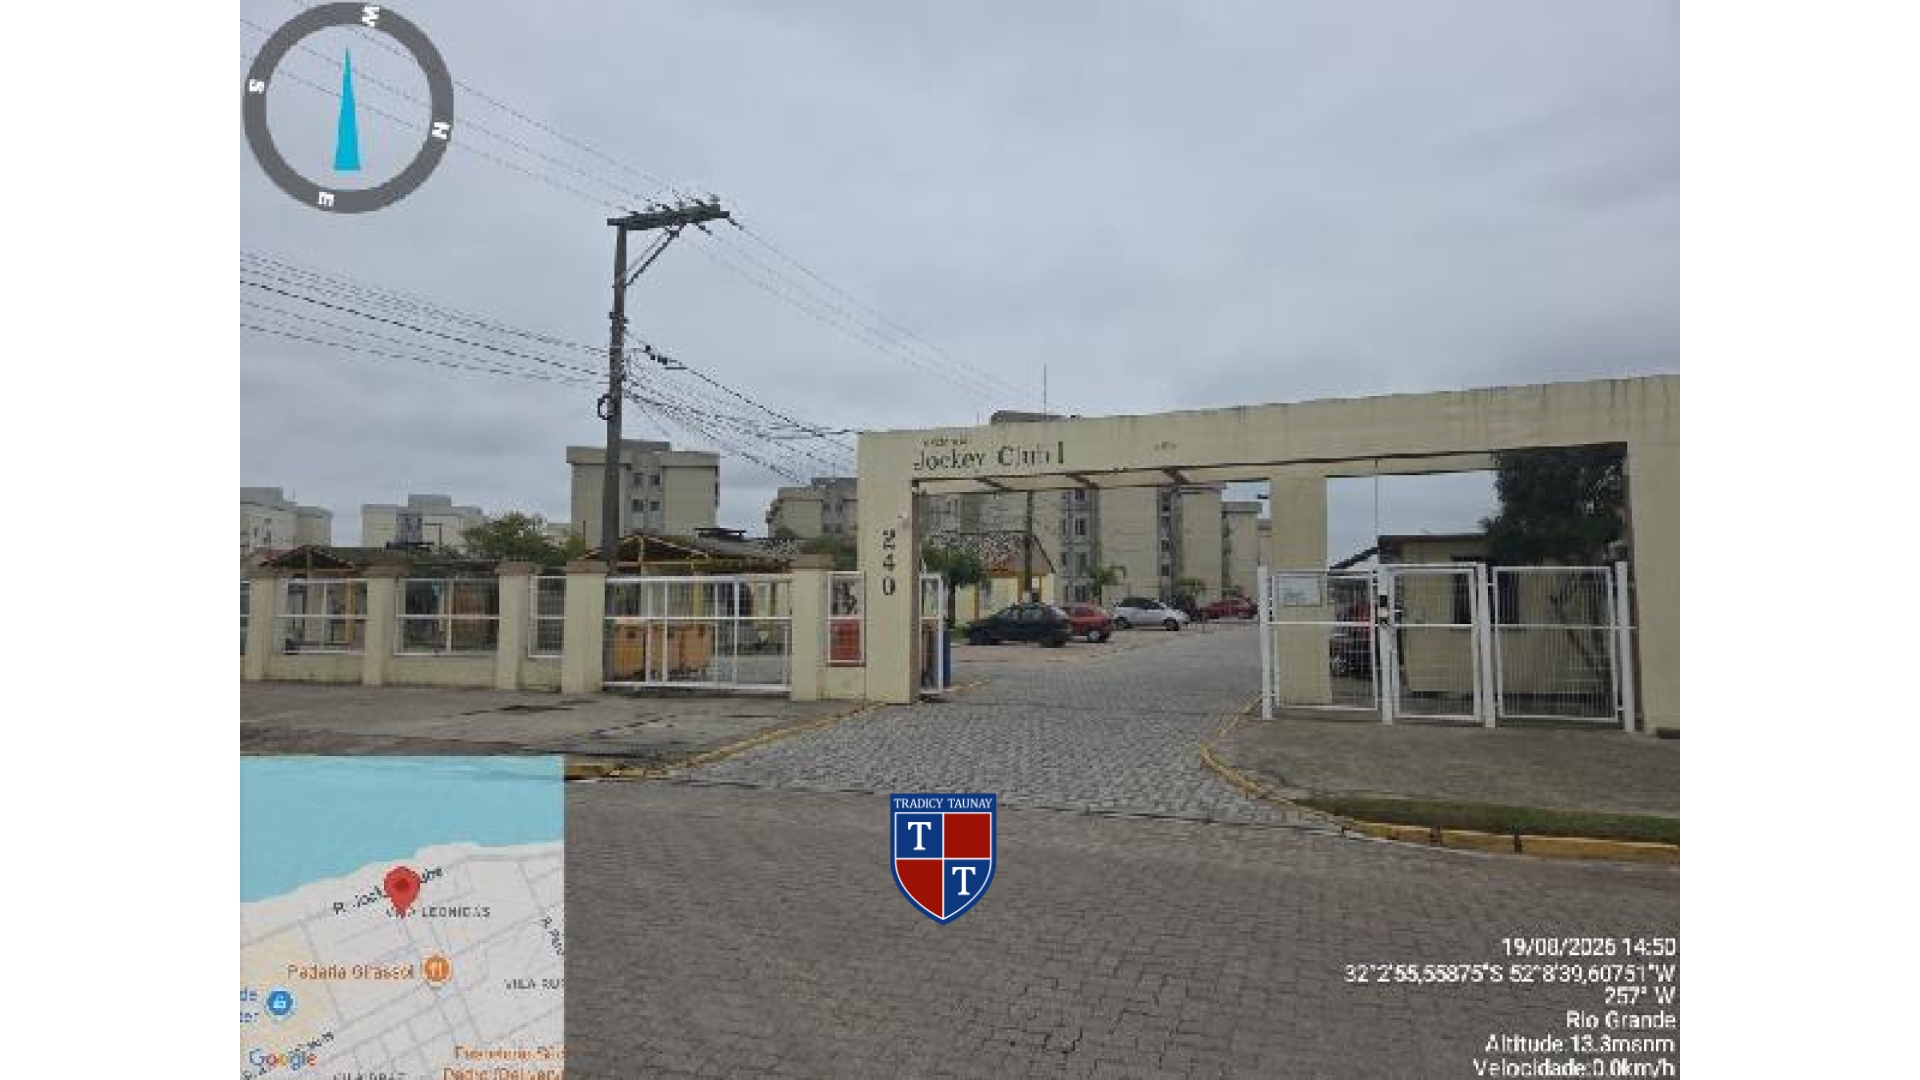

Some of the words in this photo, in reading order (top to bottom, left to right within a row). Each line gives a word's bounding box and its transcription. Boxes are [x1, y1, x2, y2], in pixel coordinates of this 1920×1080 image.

[914, 449, 986, 471] Jockey
[998, 445, 1050, 466] Club
[882, 528, 896, 596] 240
